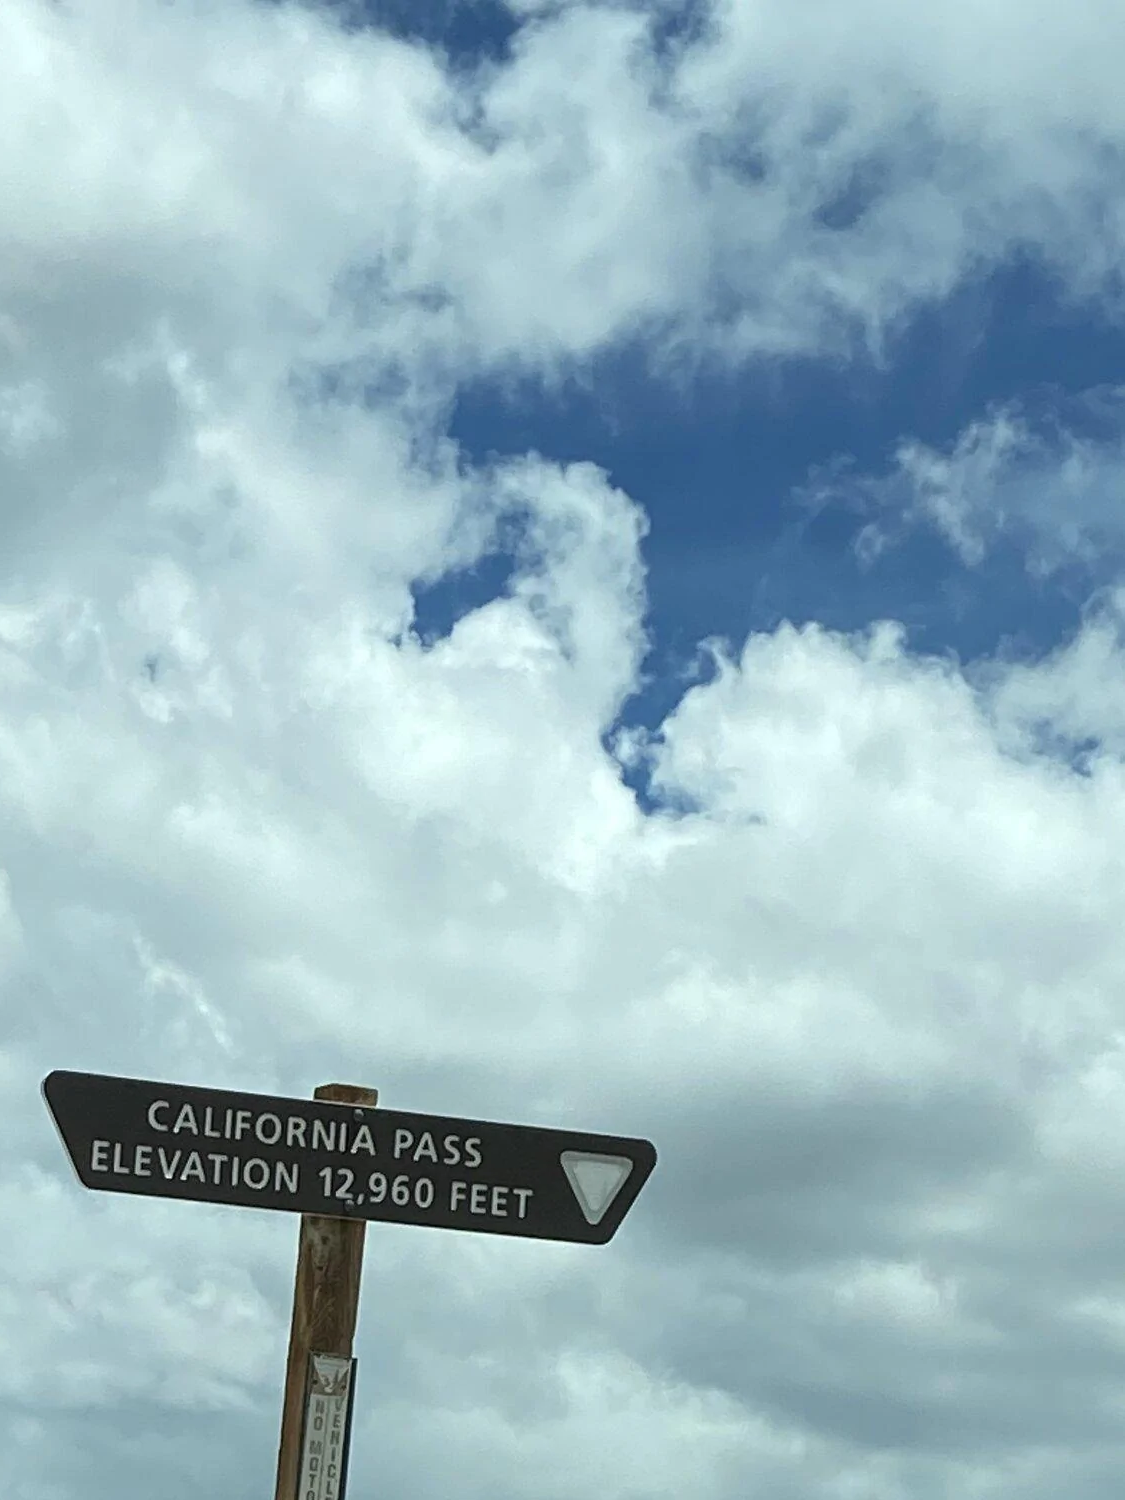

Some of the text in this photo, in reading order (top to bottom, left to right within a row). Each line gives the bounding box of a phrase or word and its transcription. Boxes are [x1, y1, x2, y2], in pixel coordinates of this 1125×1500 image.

[147, 1100, 484, 1169] CALIFORNIA PASS
[90, 1140, 534, 1219] ELEVATION 12,960 FEET
[313, 1399, 324, 1431] NO
